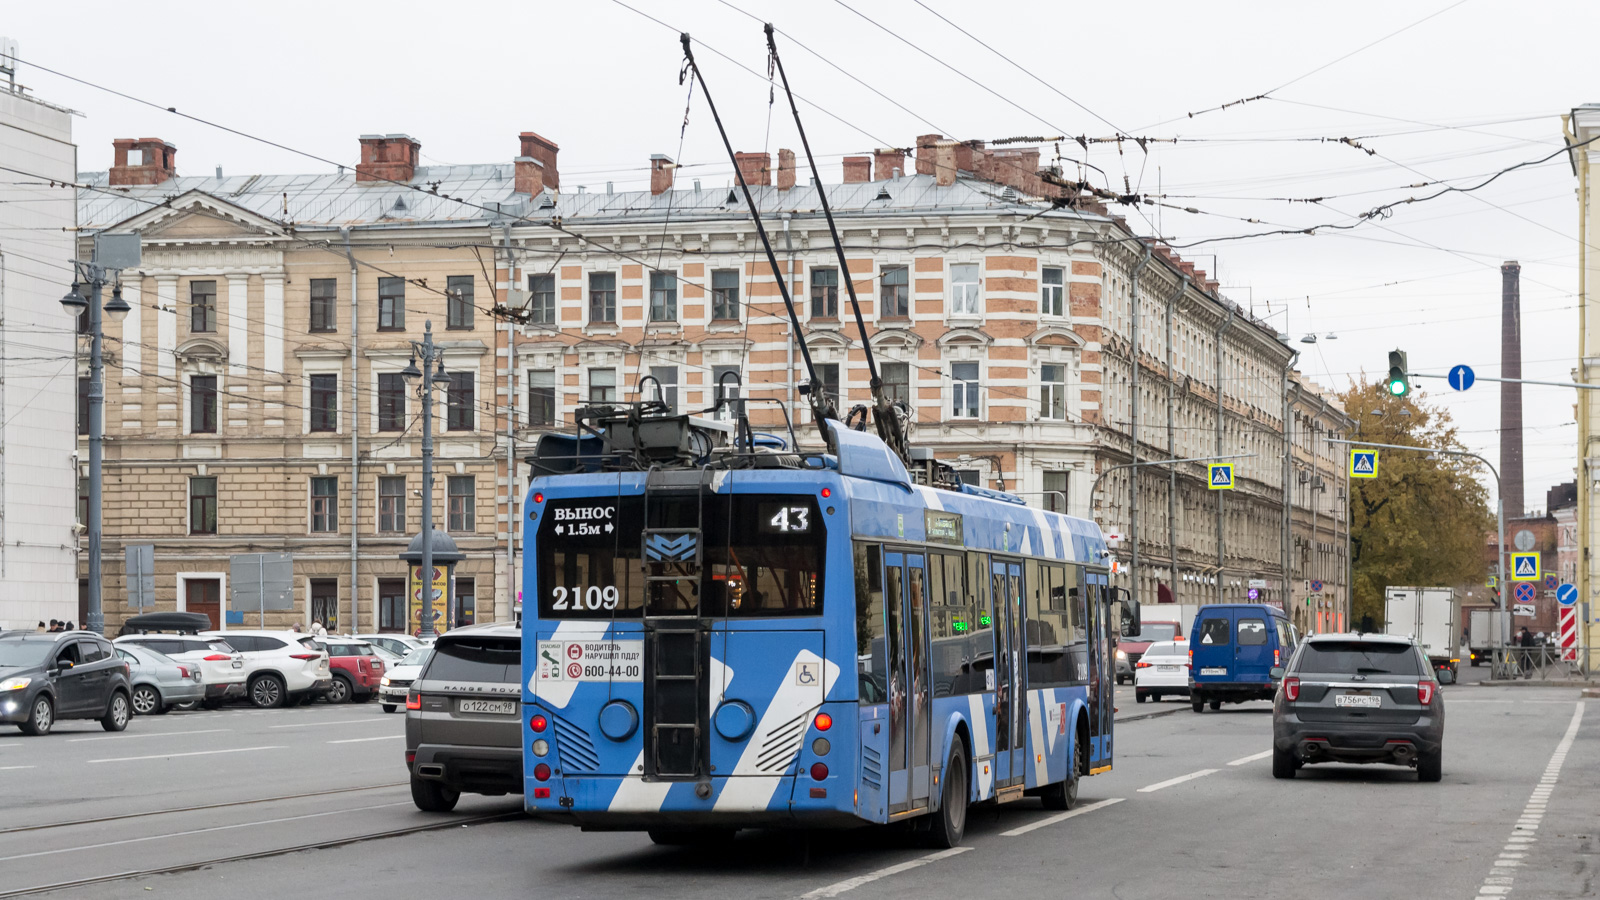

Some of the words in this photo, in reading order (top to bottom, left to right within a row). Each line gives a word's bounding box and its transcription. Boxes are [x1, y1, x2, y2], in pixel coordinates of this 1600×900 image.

[554, 507, 615, 520] ВЫНОС
[770, 507, 808, 531] 43
[568, 523, 600, 535] 1.5м
[552, 586, 619, 610] 2109
[584, 644, 621, 652] ВОДИТЕЛЬ
[584, 665, 639, 677] 600-44-00
